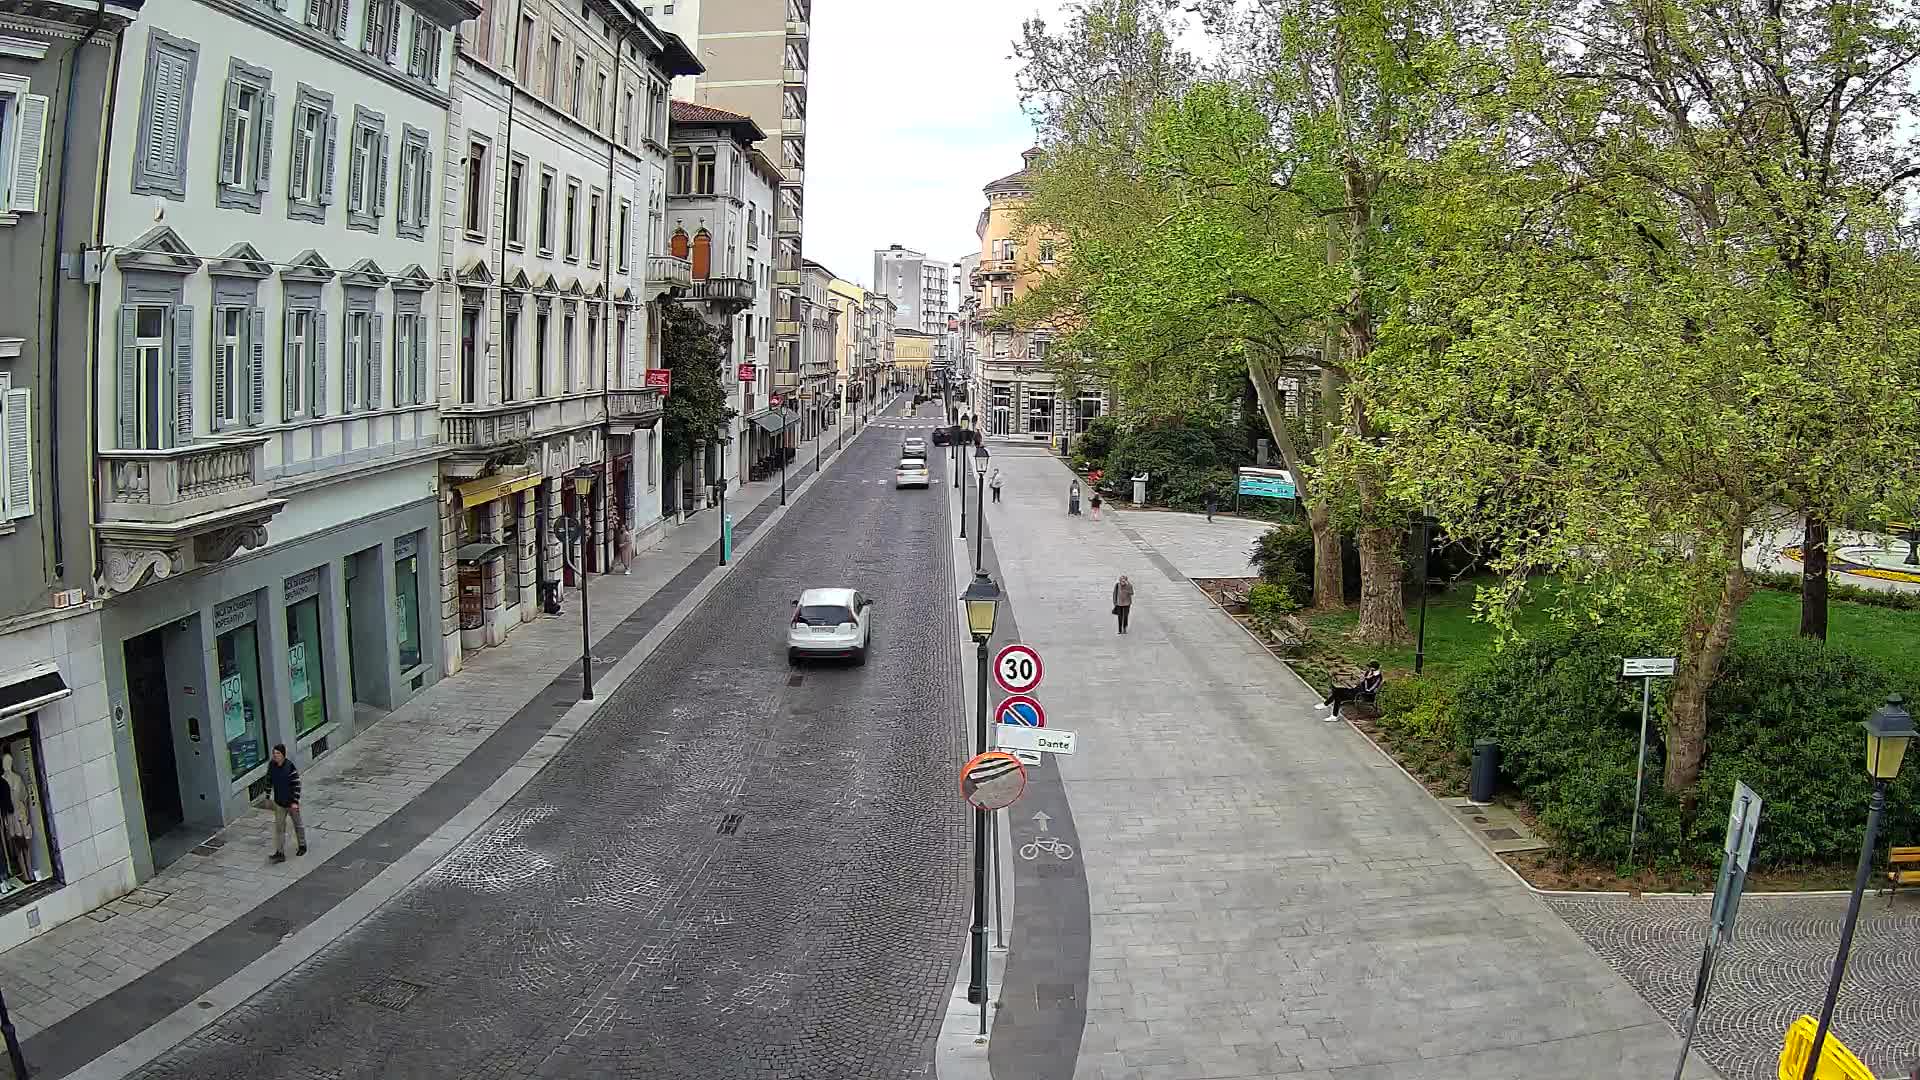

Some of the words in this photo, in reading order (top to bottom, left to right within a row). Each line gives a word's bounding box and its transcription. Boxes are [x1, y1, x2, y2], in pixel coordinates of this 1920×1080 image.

[1005, 659, 1033, 680] 30
[223, 677, 240, 700] 130
[1039, 738, 1069, 749] Dante
